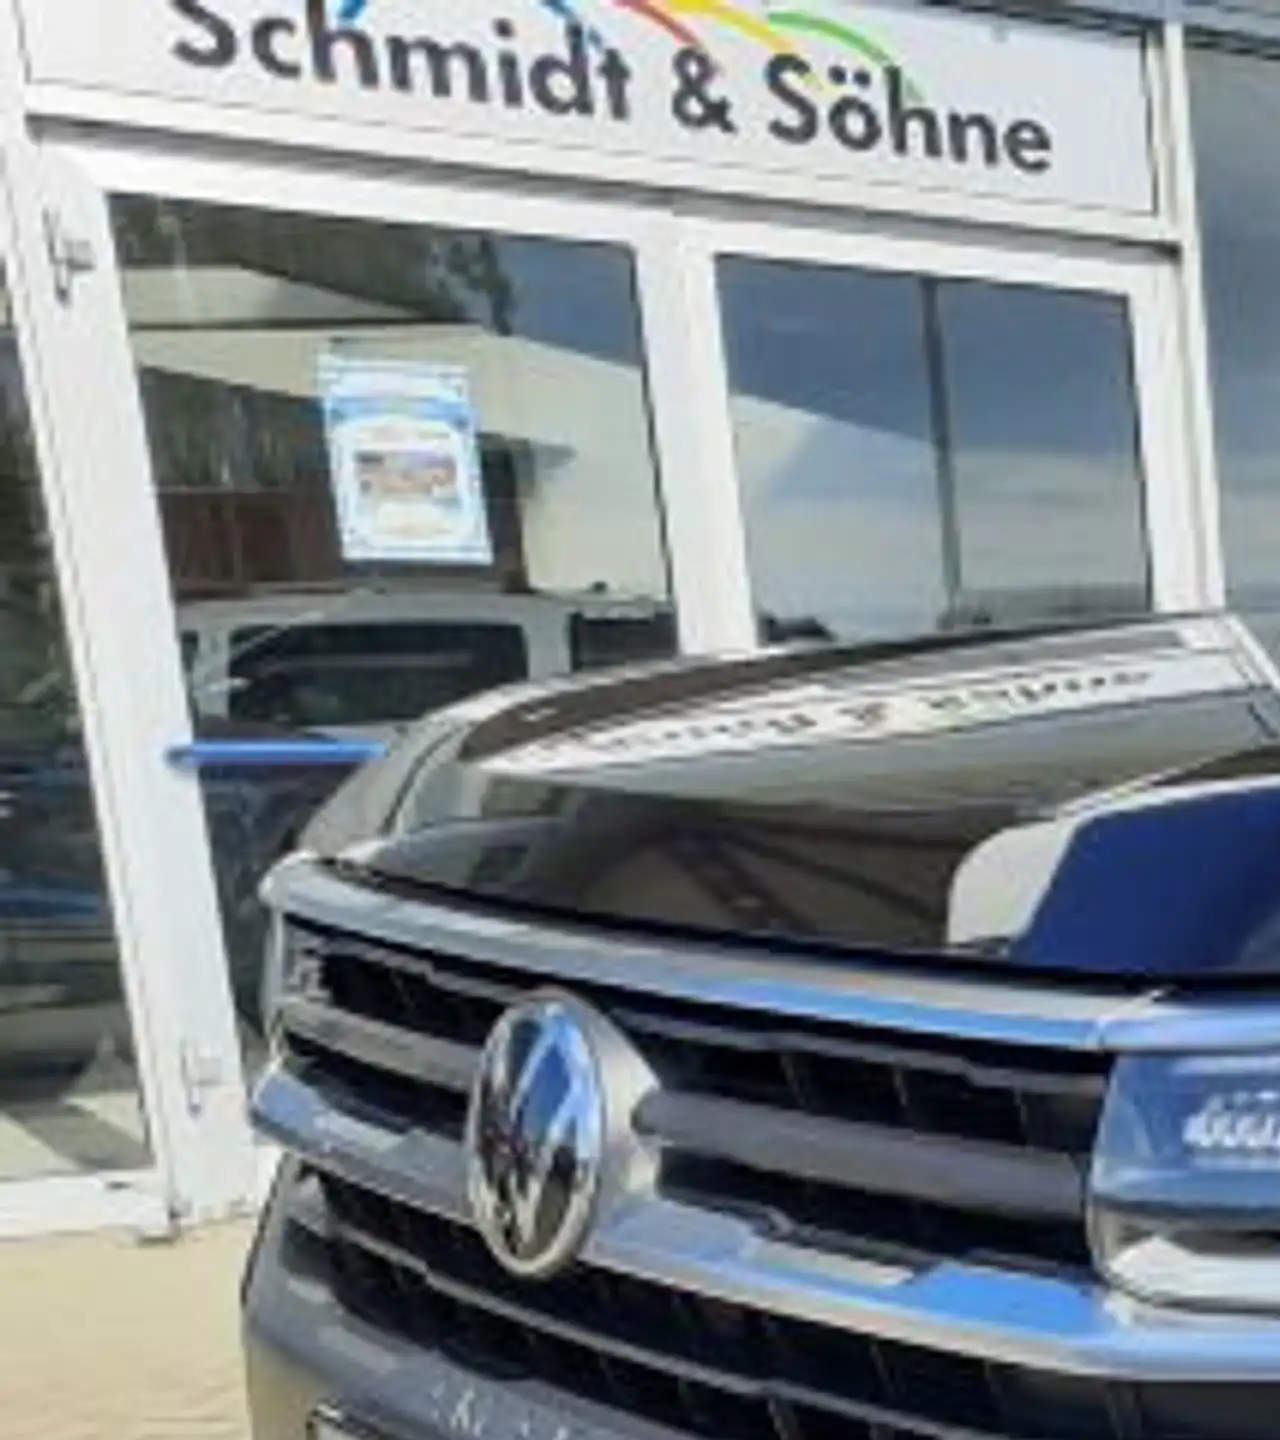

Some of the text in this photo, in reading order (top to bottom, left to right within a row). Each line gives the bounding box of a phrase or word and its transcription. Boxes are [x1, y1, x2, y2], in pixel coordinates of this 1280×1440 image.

[171, 0, 1053, 174] Schmidt & Söhne
